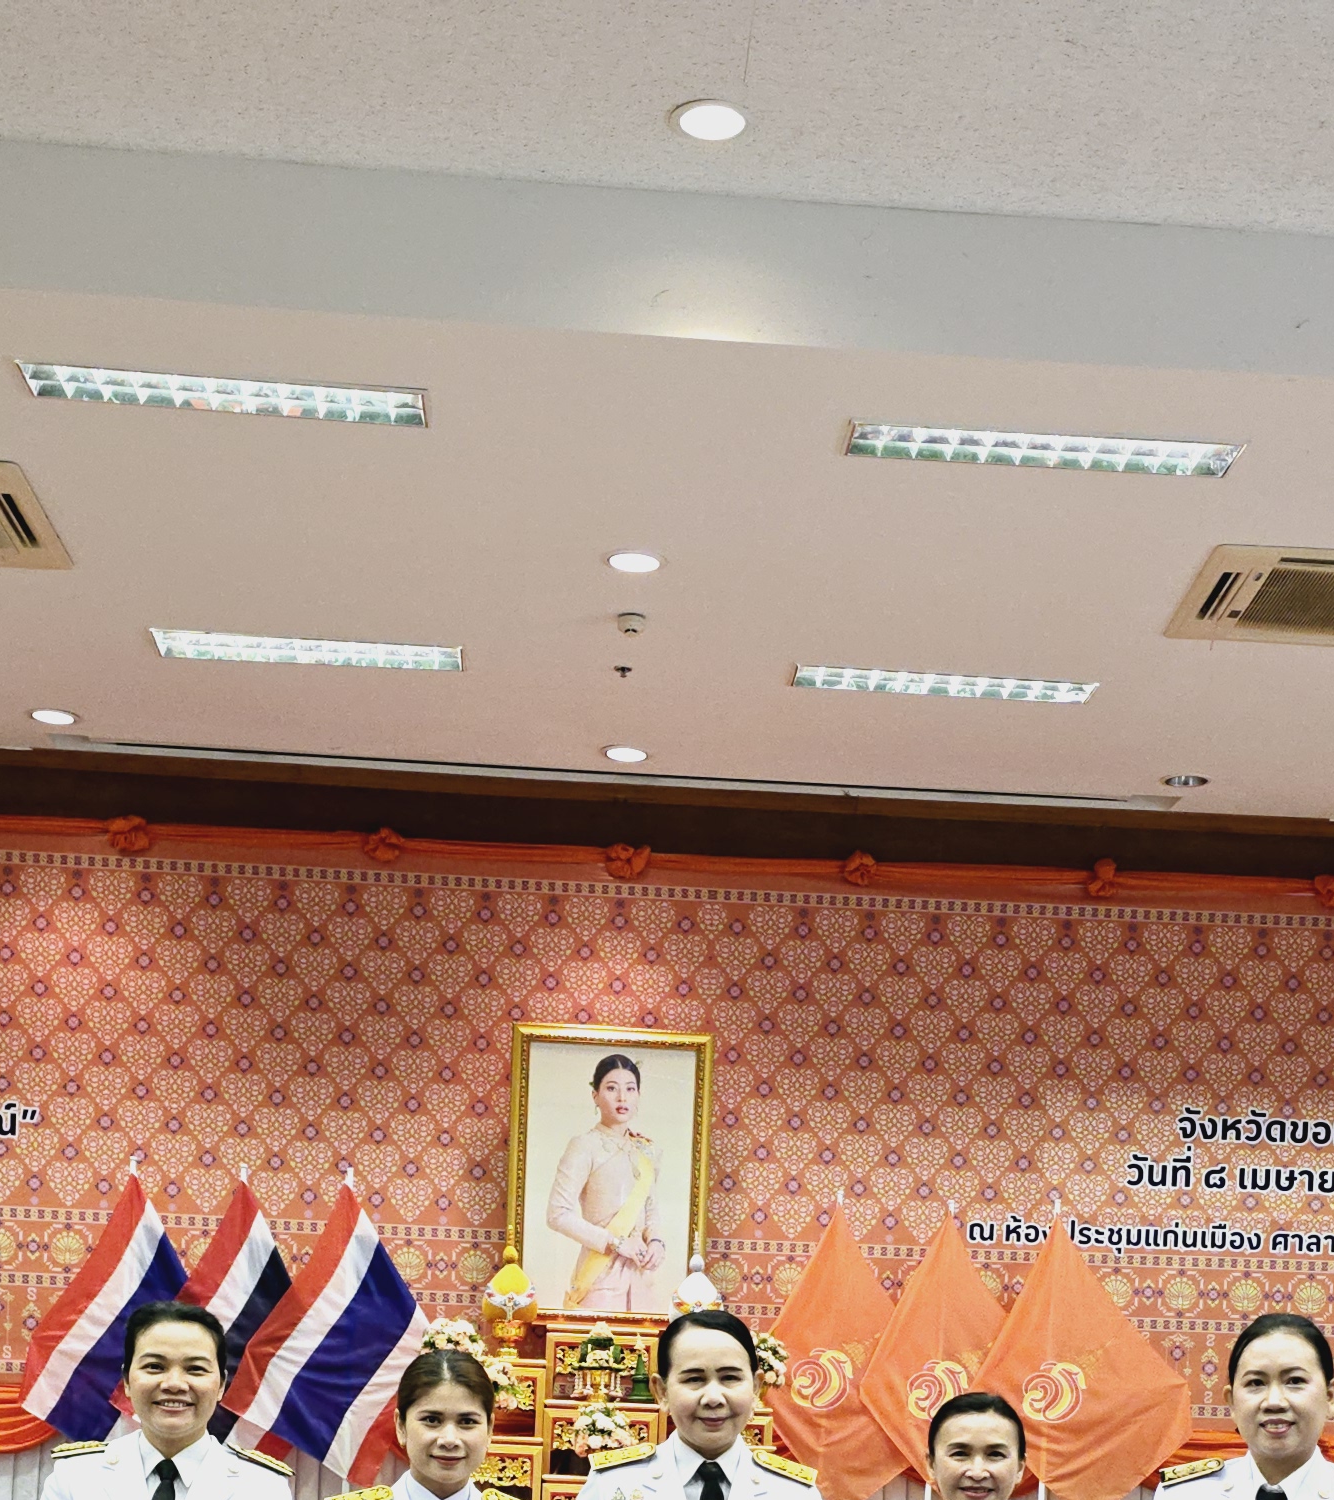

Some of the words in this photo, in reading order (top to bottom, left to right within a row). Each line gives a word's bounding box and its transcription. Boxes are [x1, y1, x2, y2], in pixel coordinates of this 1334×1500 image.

[1126, 1145, 1193, 1188] วันที่
[1203, 1165, 1228, 1189] ๘
[968, 1222, 996, 1242] ณ
